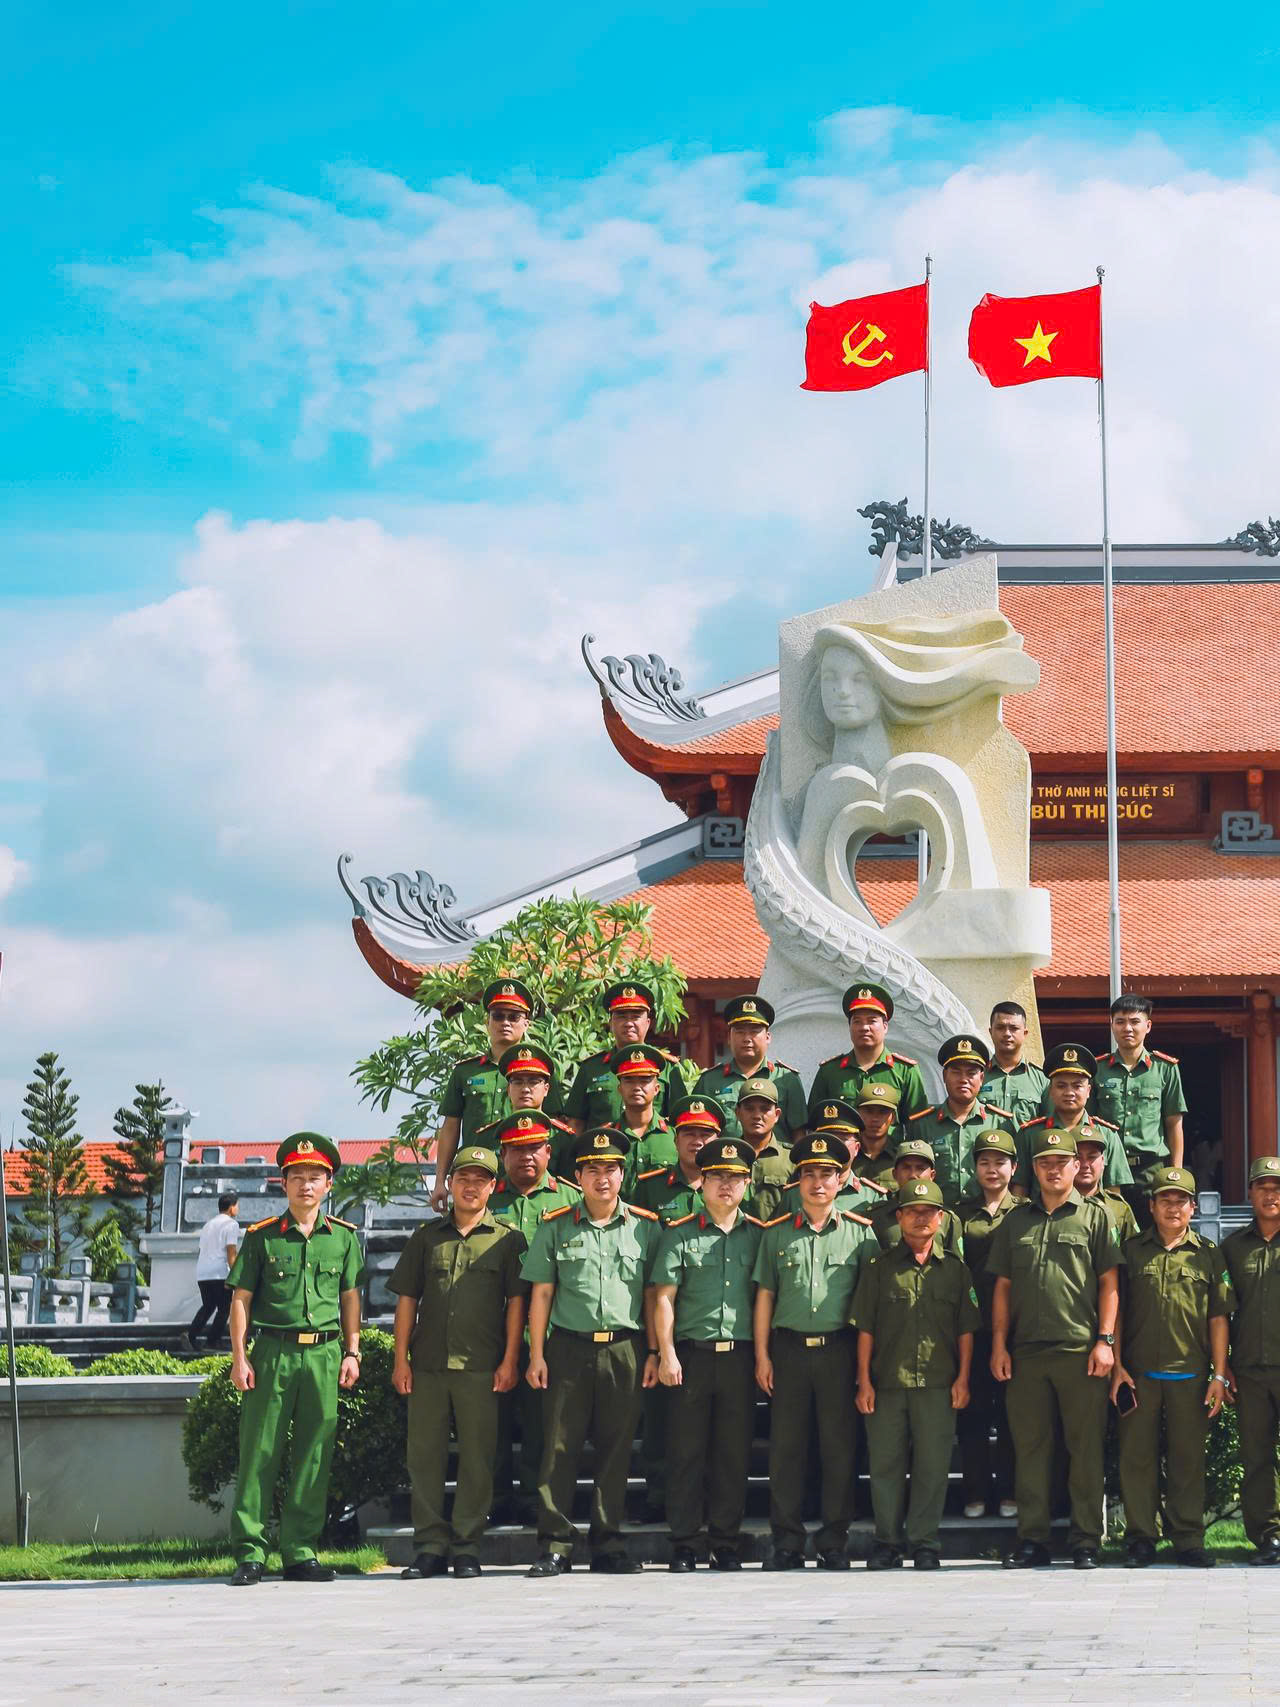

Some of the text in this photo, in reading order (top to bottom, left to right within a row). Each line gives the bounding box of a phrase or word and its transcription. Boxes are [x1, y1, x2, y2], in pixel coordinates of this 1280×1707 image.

[1037, 785, 1062, 798] THỜ
[1065, 786, 1090, 798] ANH
[1131, 784, 1158, 799] LIỆT
[1162, 784, 1175, 797] SĨ
[1032, 801, 1066, 820] BÙI
[1071, 804, 1106, 823] THỊ
